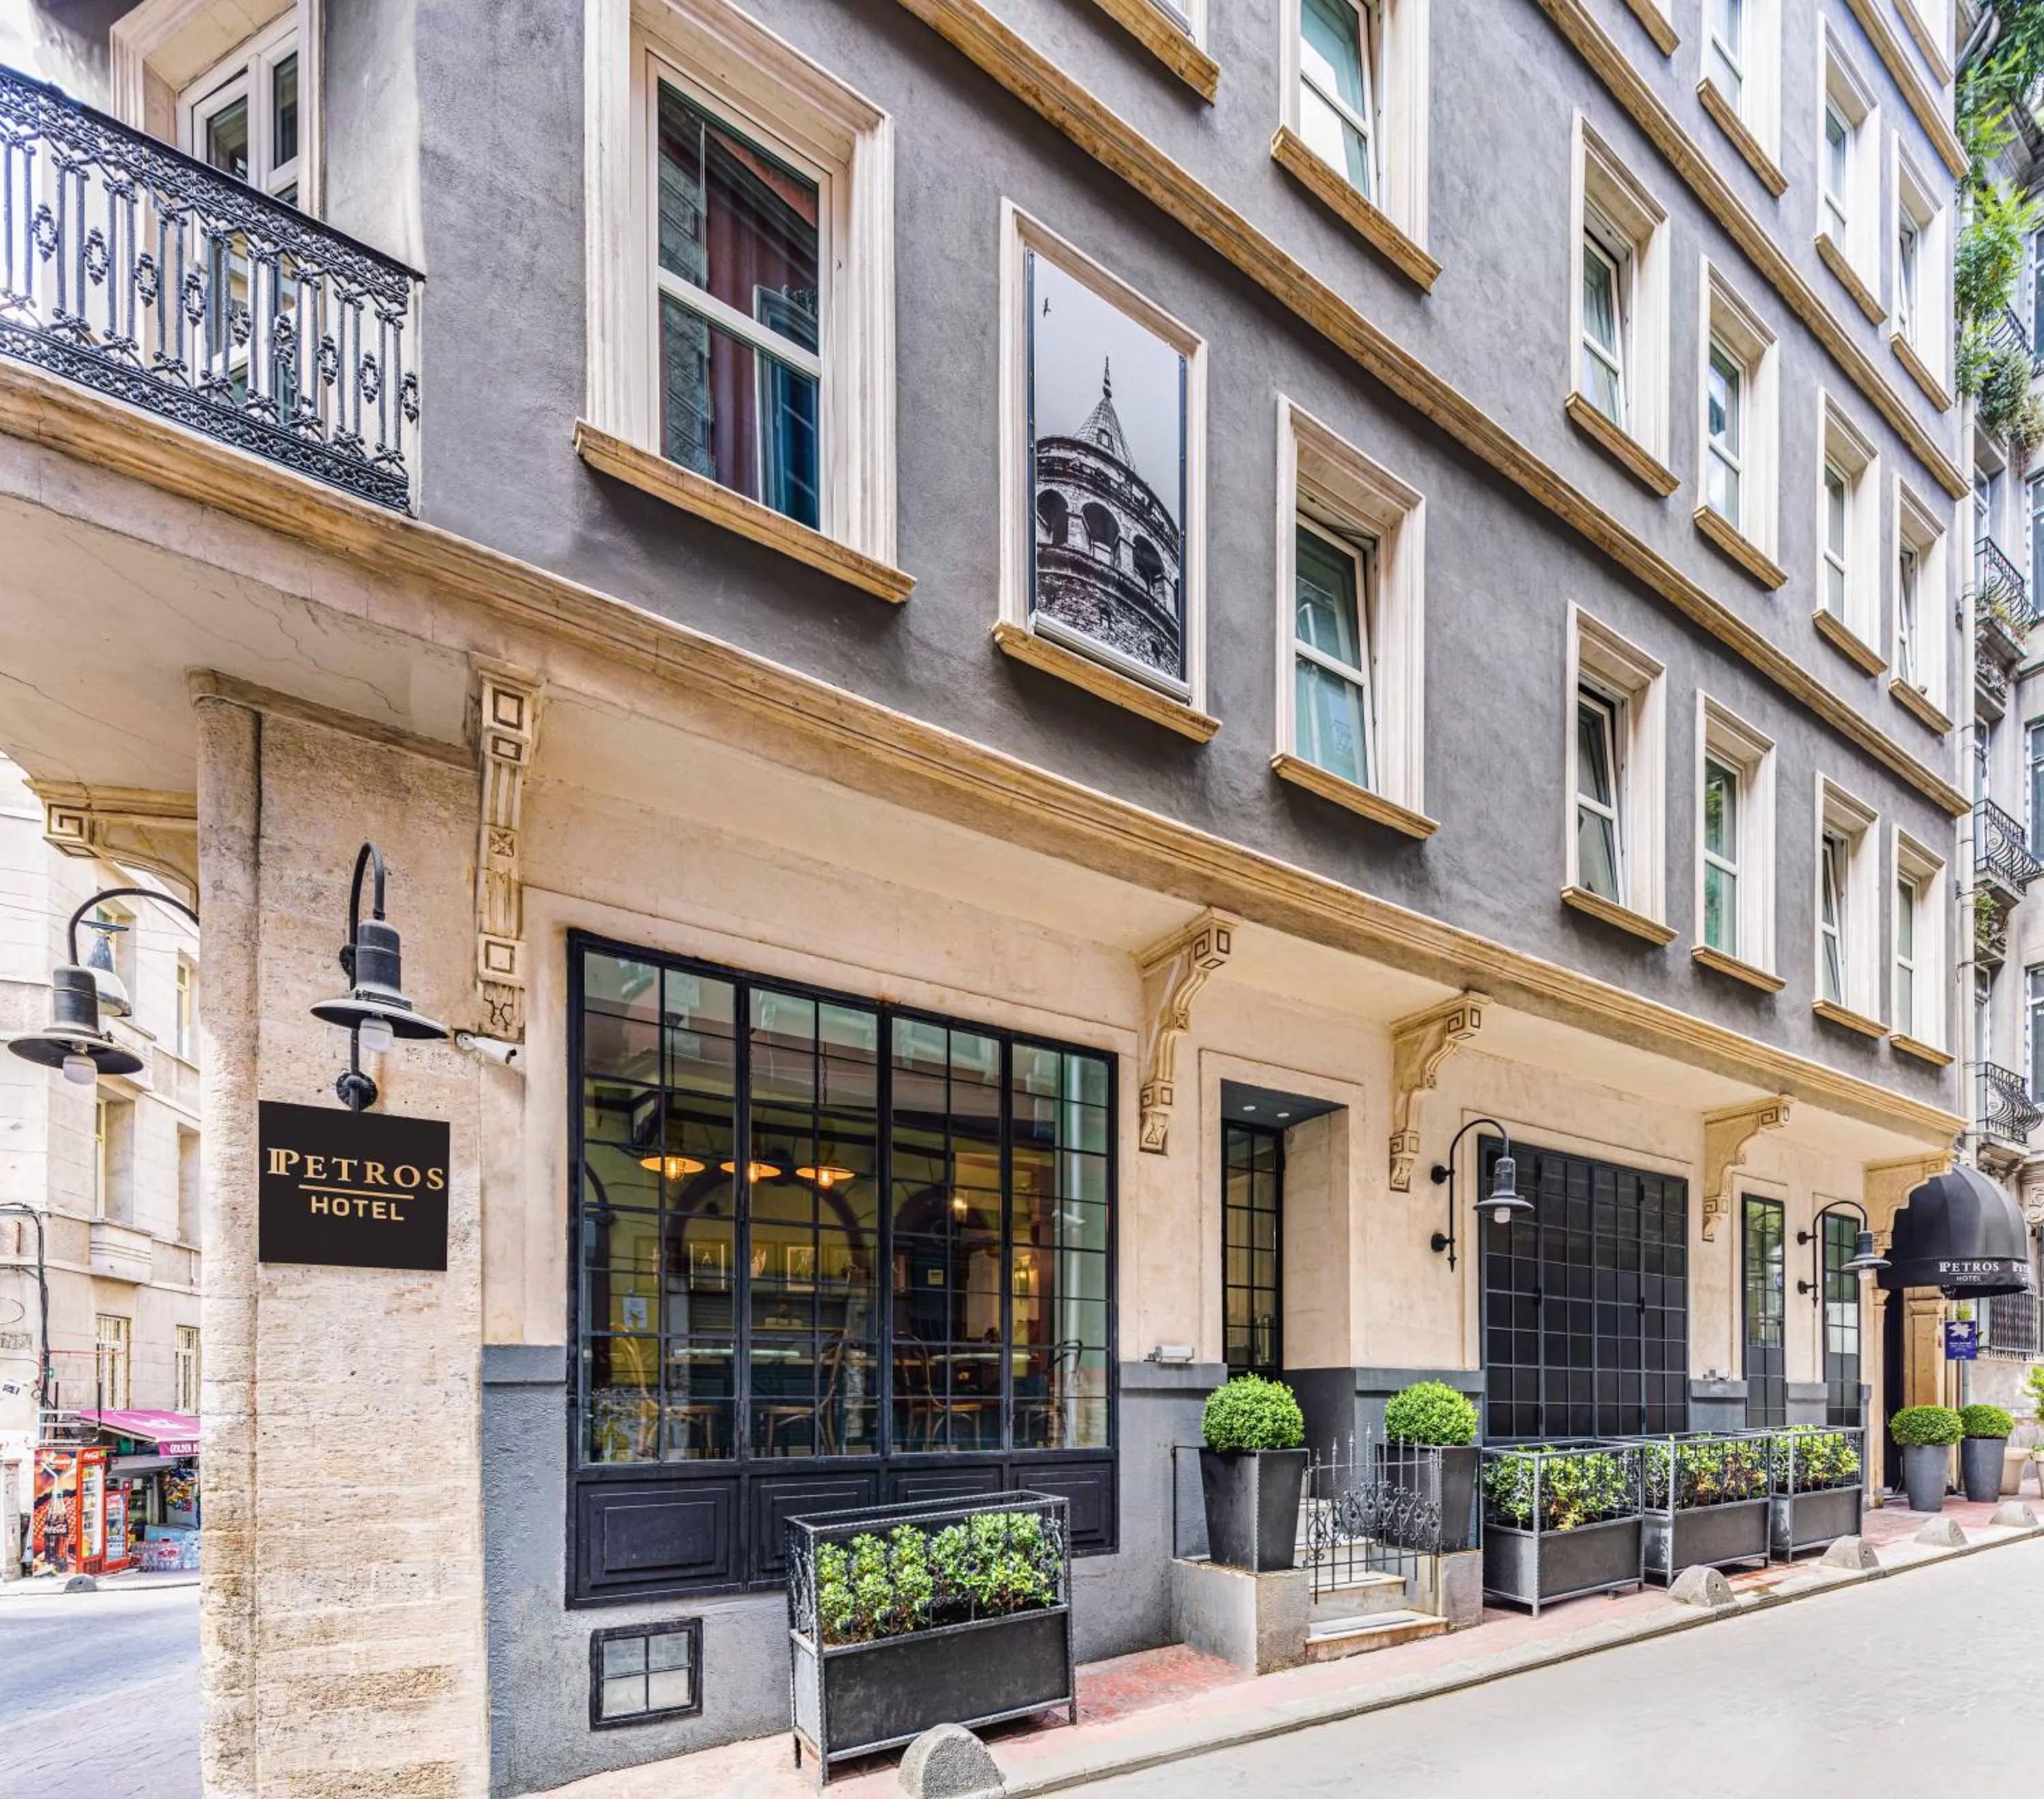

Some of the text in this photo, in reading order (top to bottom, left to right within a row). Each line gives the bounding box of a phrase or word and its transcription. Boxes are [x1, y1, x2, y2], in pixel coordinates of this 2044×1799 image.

[267, 1148, 445, 1190] PETROS
[311, 1195, 405, 1221] HOTEL
[1939, 1261, 2000, 1273] PETROS
